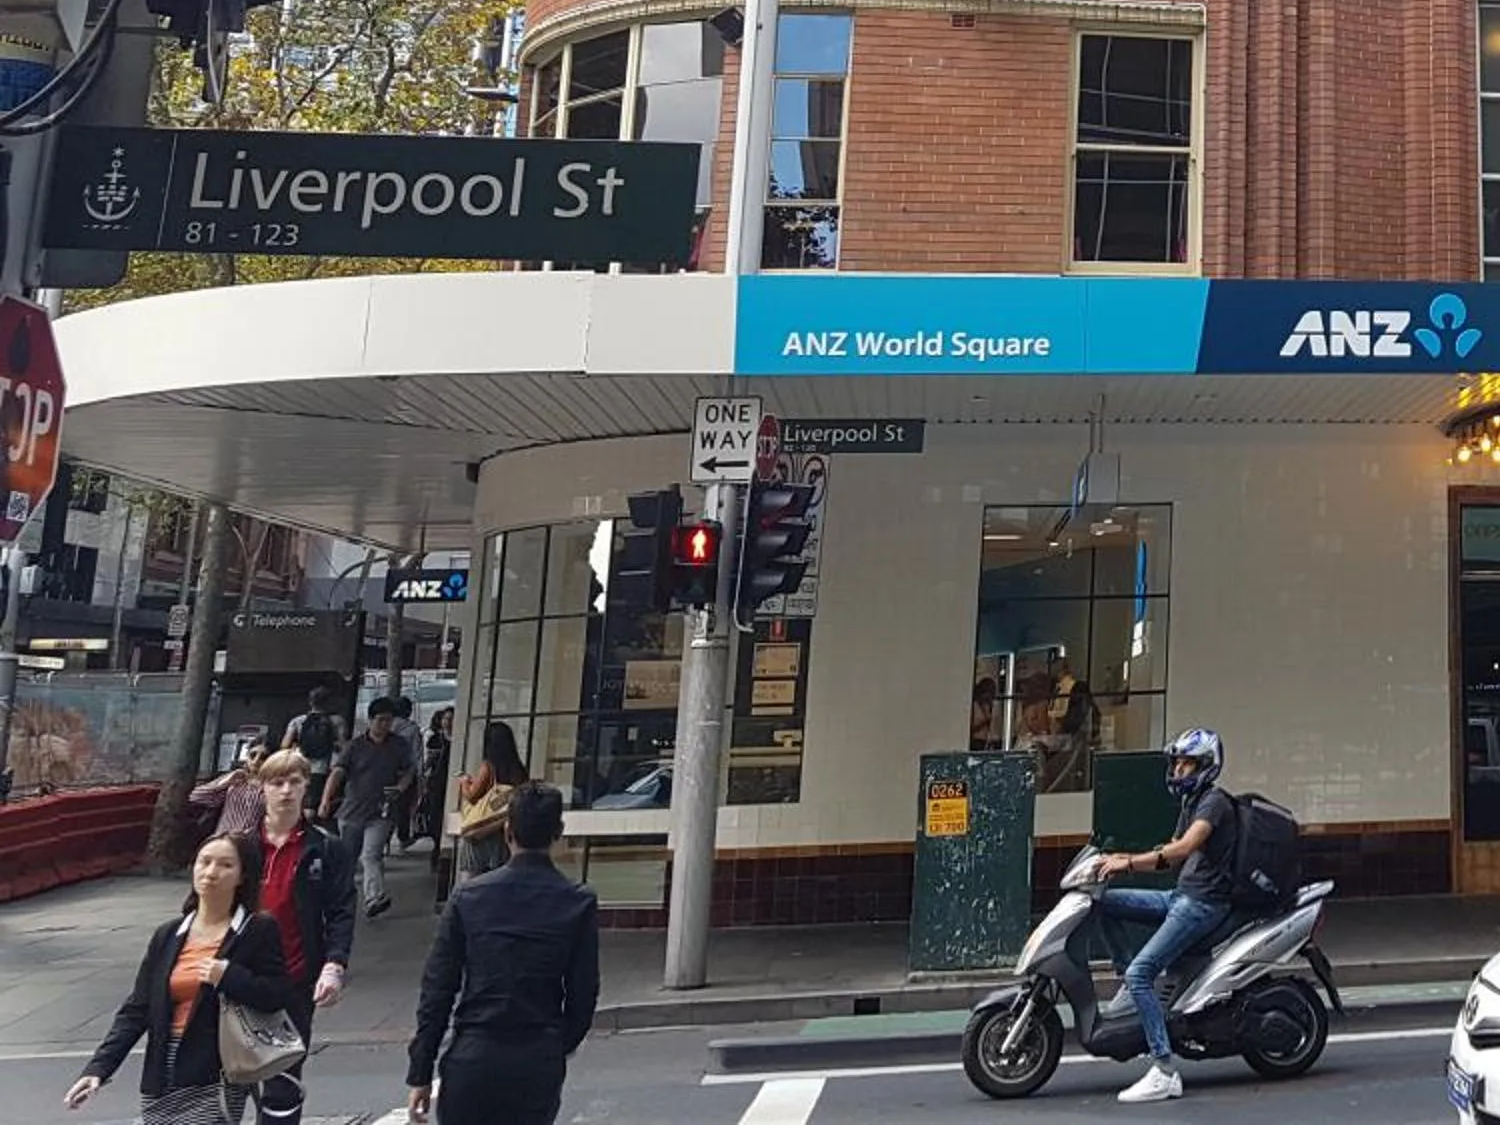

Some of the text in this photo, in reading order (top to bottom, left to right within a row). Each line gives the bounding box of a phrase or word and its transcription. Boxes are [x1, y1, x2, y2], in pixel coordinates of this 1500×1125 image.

[190, 150, 625, 229] Liverpool St
[186, 222, 216, 245] 81
[251, 223, 301, 248] 123
[1279, 310, 1412, 357] ANZ
[783, 331, 1050, 362] ANZ World Square
[705, 404, 751, 424] ONE
[701, 430, 752, 451] WAY
[784, 424, 905, 446] Liverpool St
[757, 437, 778, 460] STOP
[392, 580, 442, 598] ANZ
[253, 614, 316, 631] Telephone
[931, 782, 964, 798] 0262
